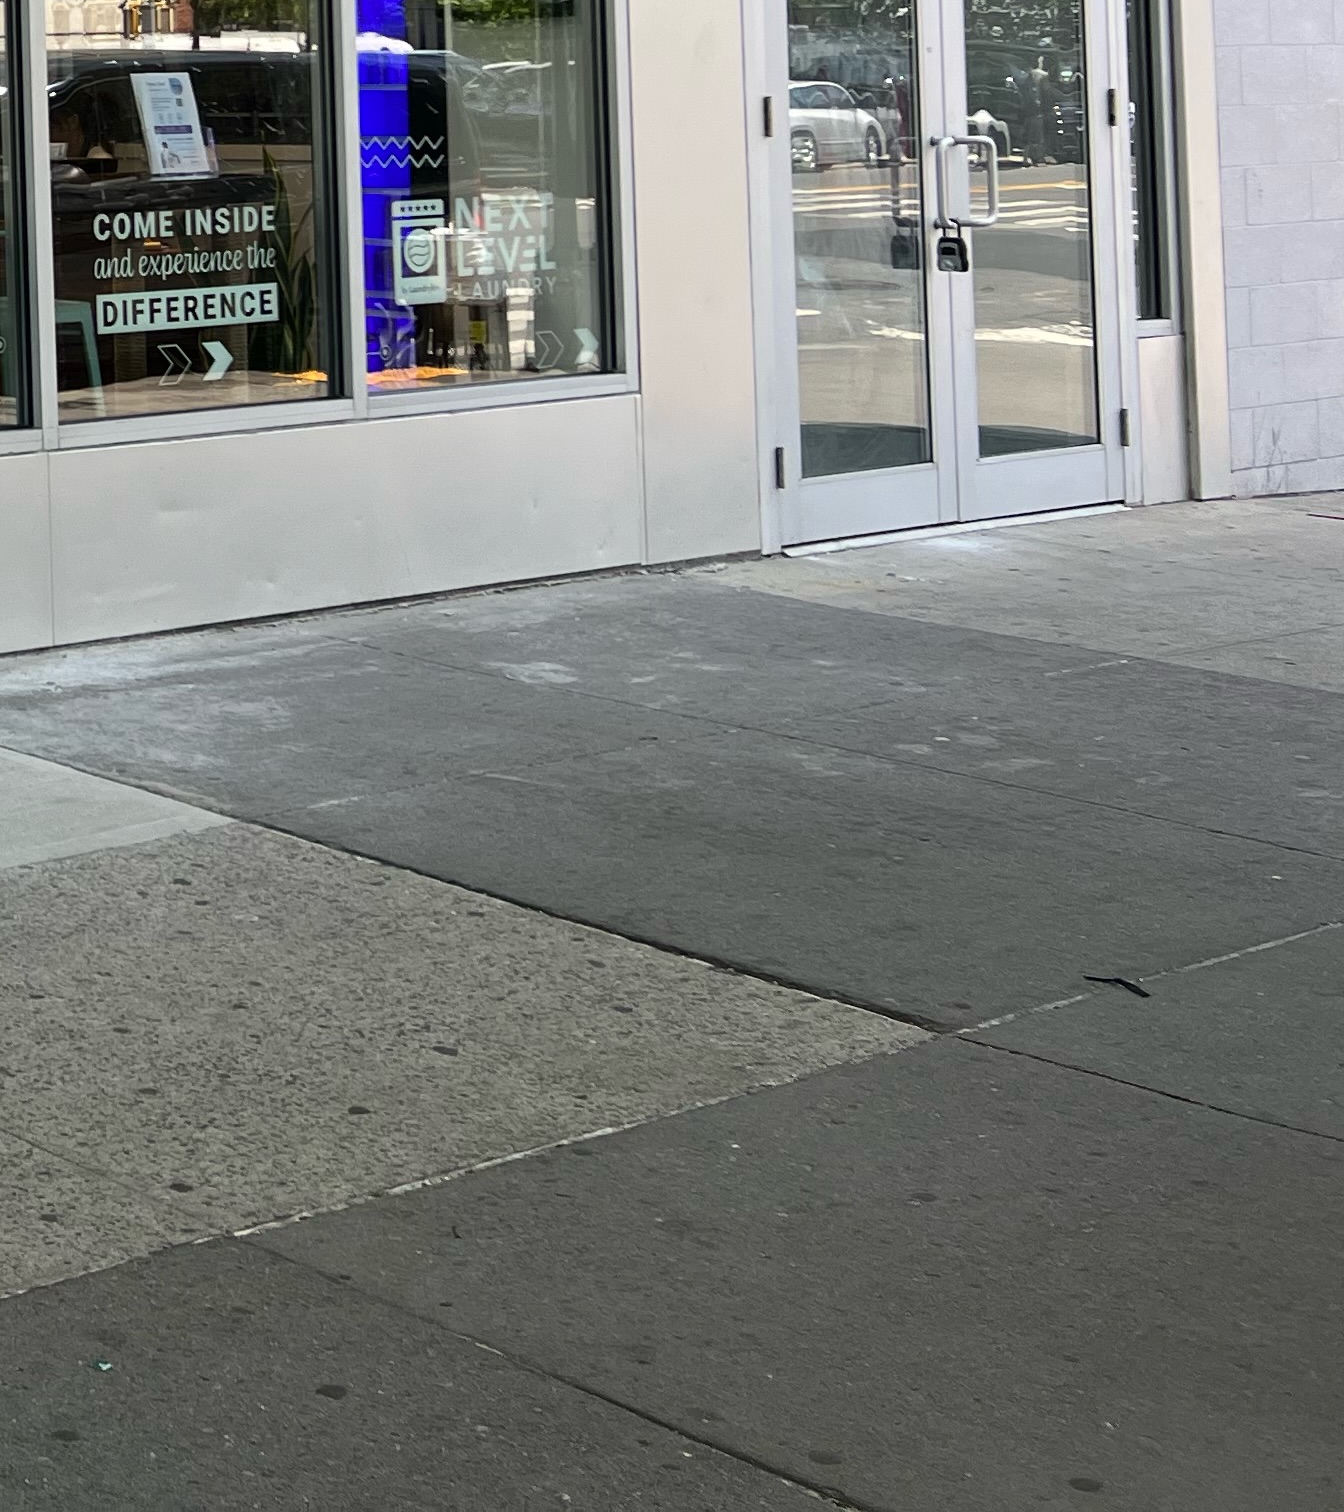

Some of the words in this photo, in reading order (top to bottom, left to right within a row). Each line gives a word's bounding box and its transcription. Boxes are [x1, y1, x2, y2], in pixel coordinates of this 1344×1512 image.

[93, 210, 174, 241] COME
[184, 205, 276, 236] INSIDE
[454, 191, 554, 233] NEXT
[94, 247, 135, 280] and
[138, 246, 243, 281] experience
[246, 240, 277, 269] the
[456, 234, 557, 277] LEVEL
[102, 289, 274, 328] DIFFERENCE
[456, 276, 558, 301] LAUNDRY
